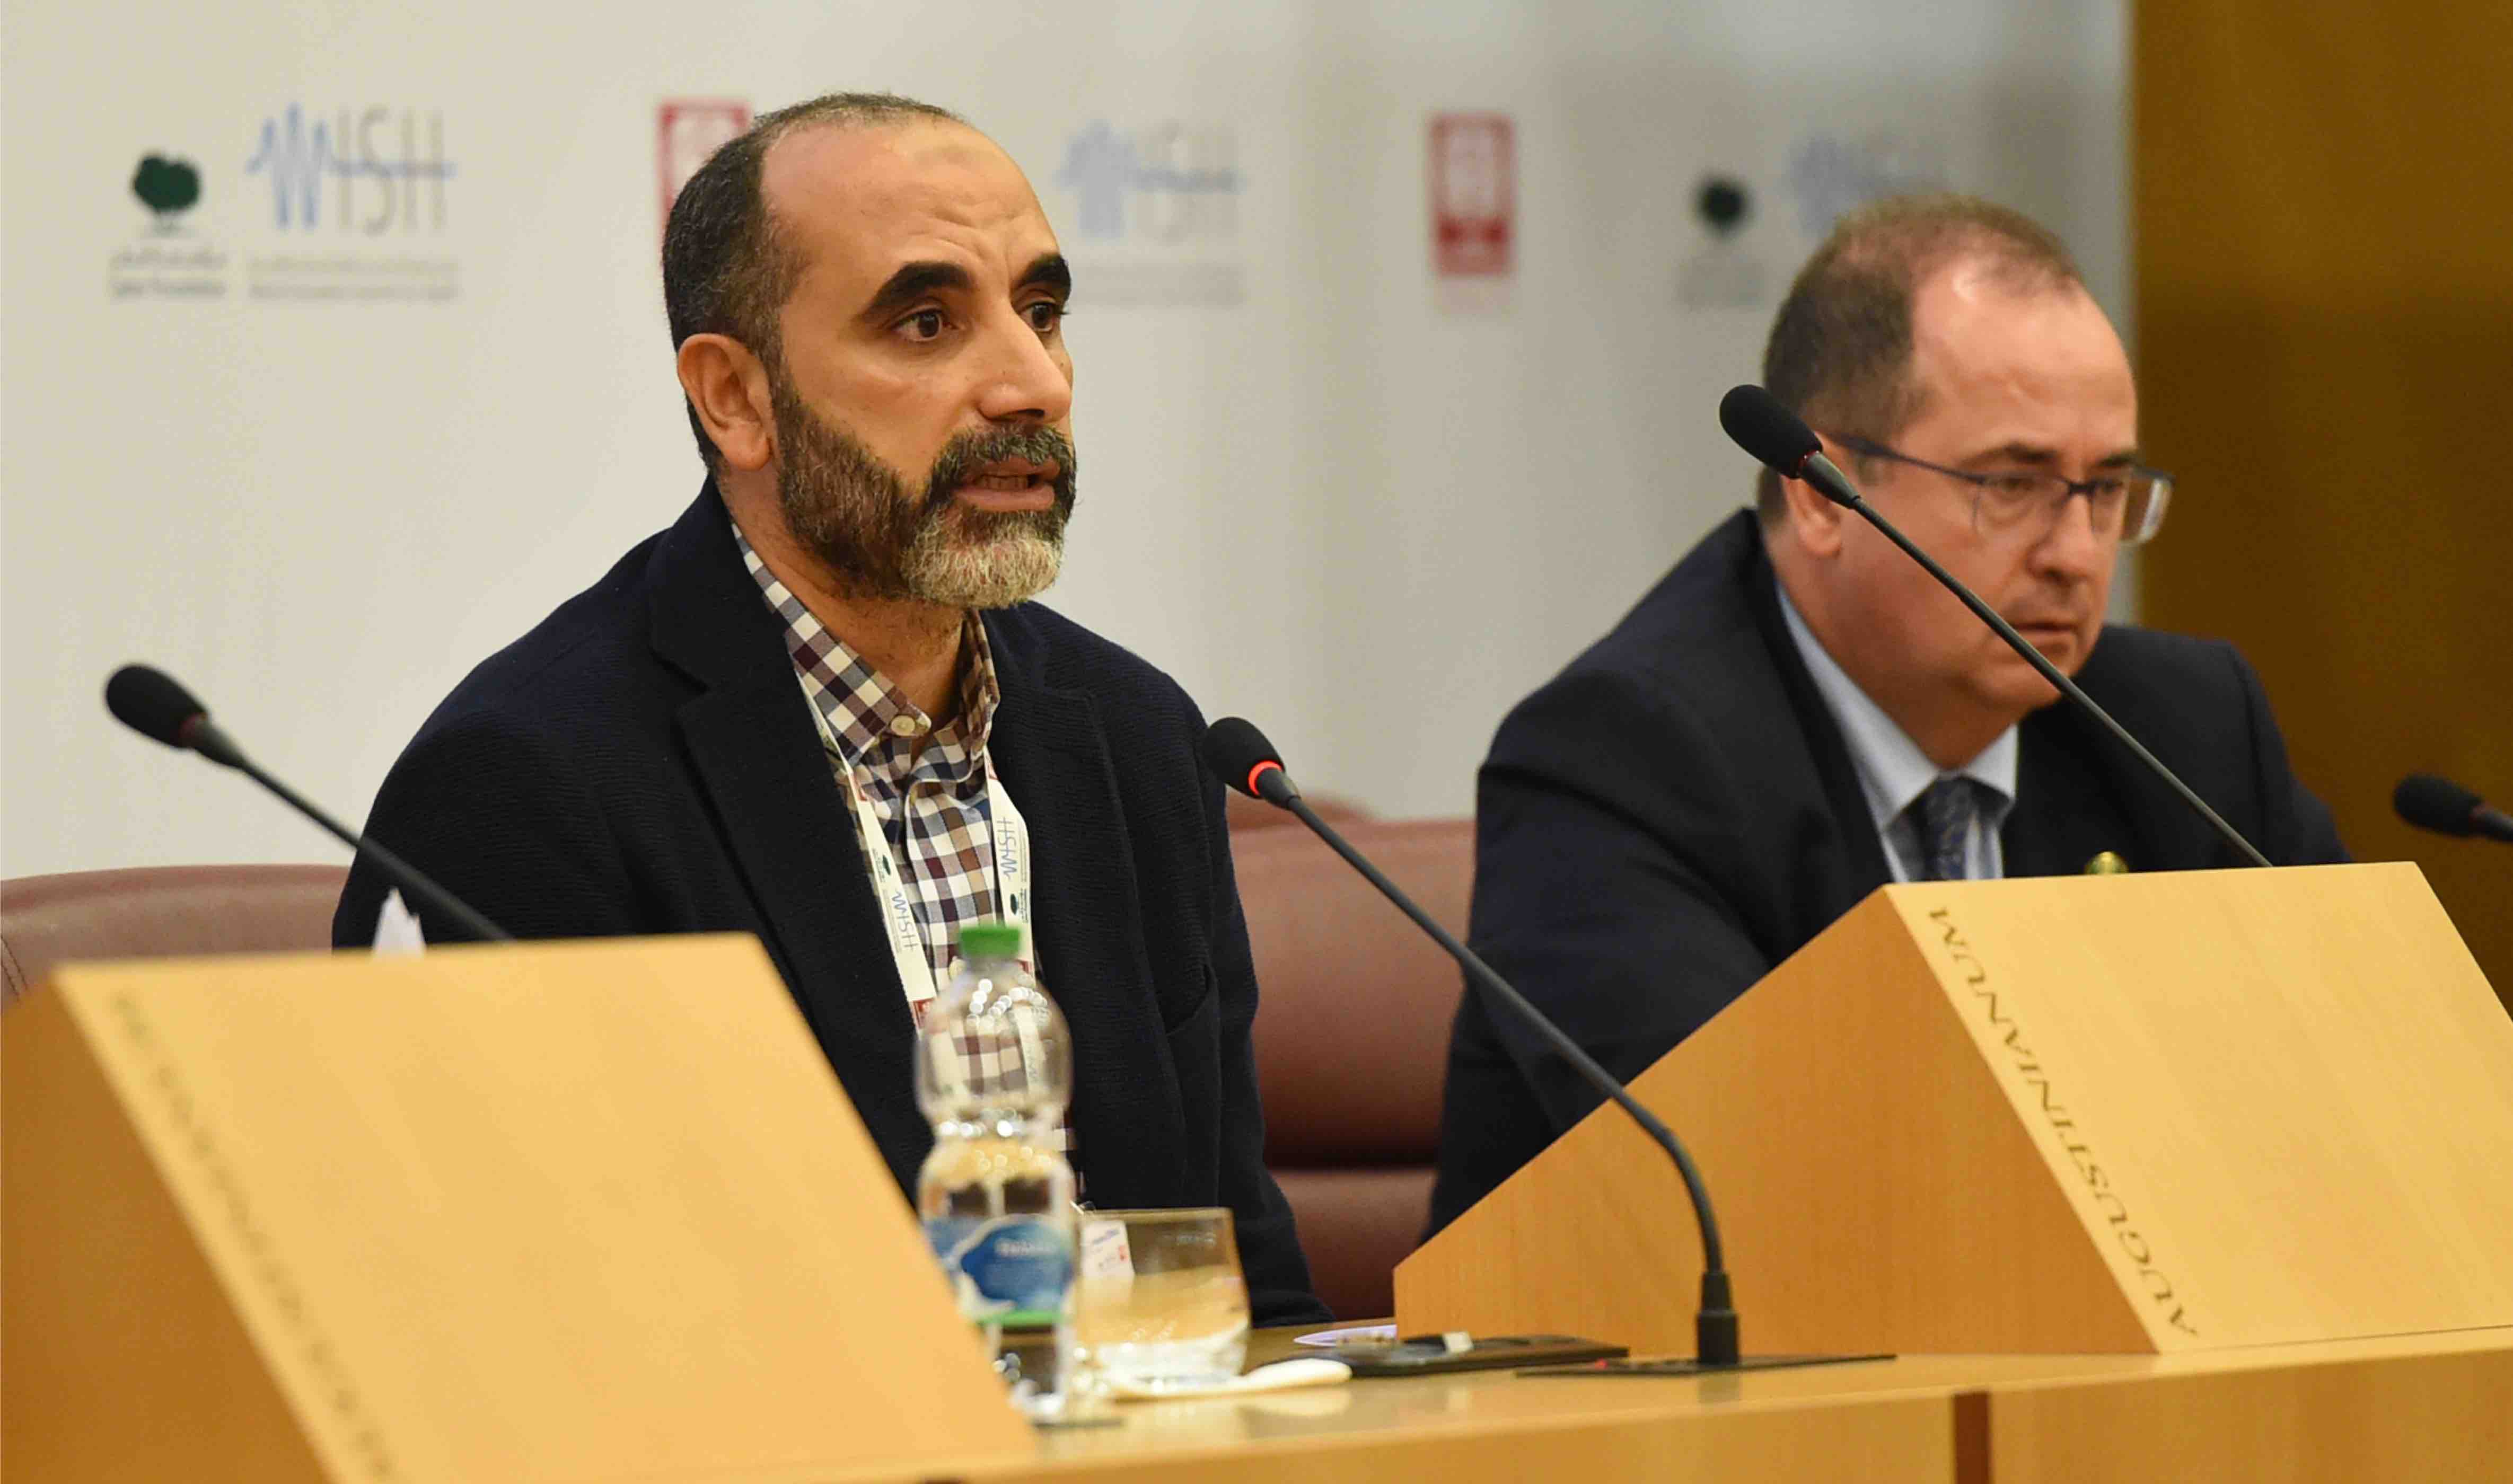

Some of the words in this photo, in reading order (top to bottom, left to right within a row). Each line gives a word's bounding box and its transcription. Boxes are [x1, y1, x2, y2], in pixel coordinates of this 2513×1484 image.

[245, 102, 458, 238] WISH
[996, 817, 1017, 881] WISH
[891, 890, 919, 951] WISH
[1929, 907, 2198, 1336] AUGUSTINIANUM
